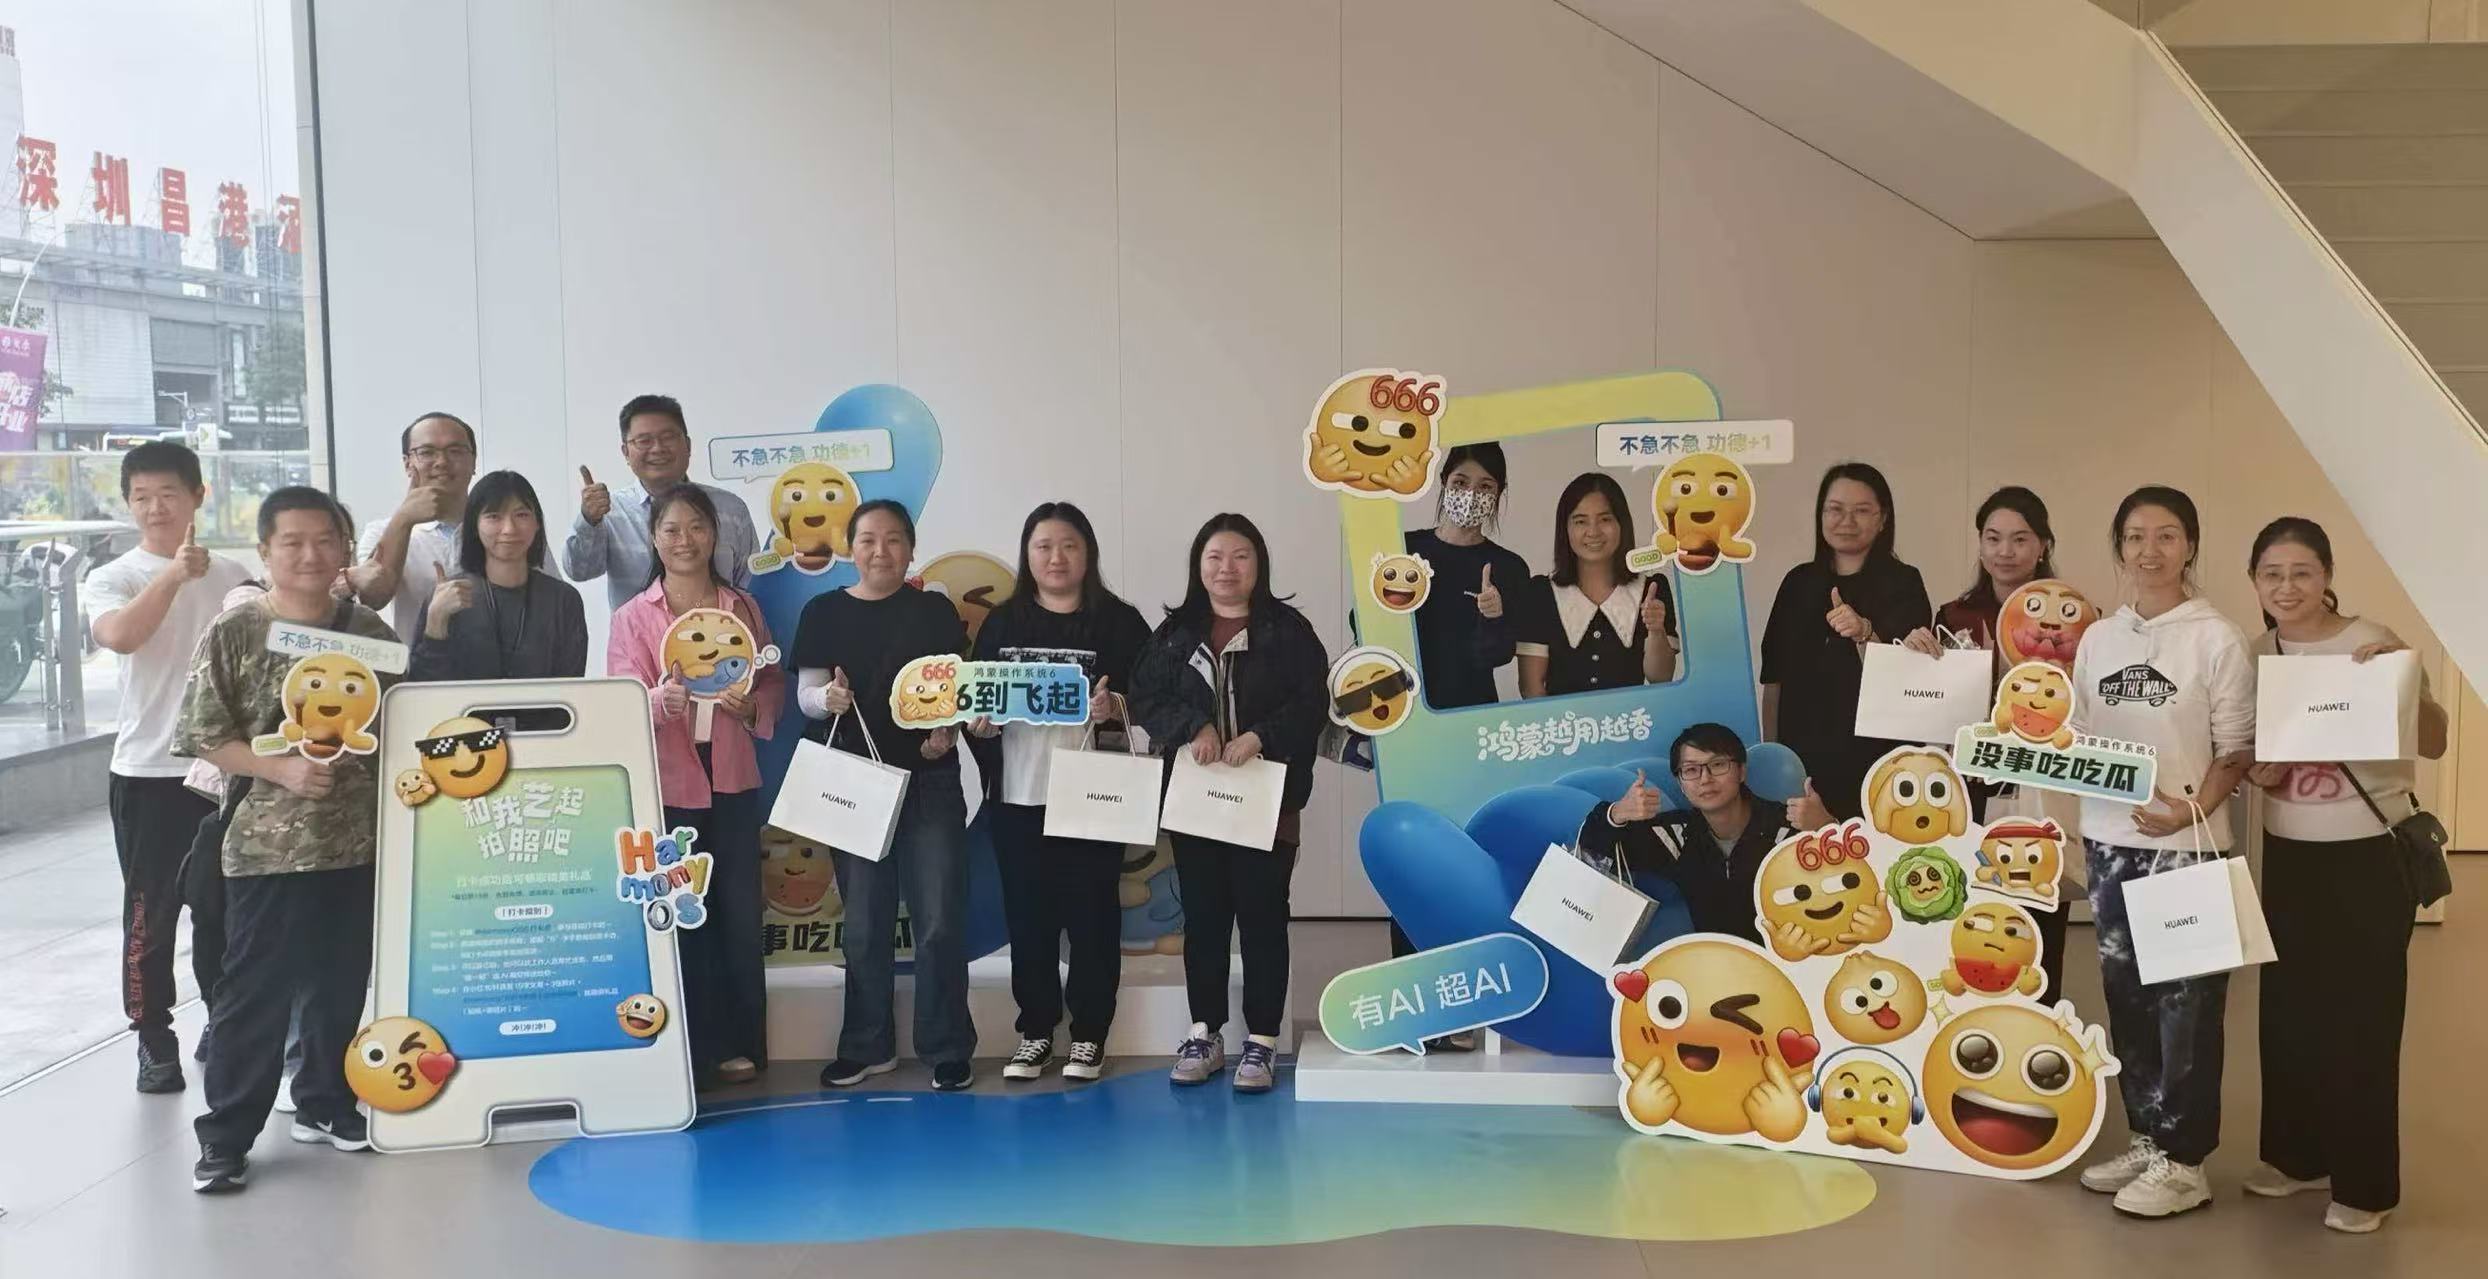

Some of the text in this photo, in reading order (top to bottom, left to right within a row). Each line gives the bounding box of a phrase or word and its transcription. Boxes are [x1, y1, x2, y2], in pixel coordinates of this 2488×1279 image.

[1370, 374, 1441, 416] 666
[731, 441, 871, 468] 不急不急 功德+1
[1619, 432, 1772, 456] 不急不急 功德+1
[921, 661, 957, 681] 666
[973, 666, 1057, 679] 鸿蒙操作系统6
[2121, 667, 2151, 681] VANS
[956, 680, 1081, 716] 6到飞起
[1903, 688, 1945, 700] HUAWEI
[2122, 680, 2141, 697] THE
[2307, 702, 2351, 715] HUAWEI
[1477, 706, 1654, 762] 鸿蒙越用越香
[2075, 734, 2156, 757] 鸿蒙操作系统6
[1970, 740, 2141, 793] 没事吃吃瓜
[459, 781, 585, 829] 和我艺起
[821, 791, 857, 811] HUAWEI
[1086, 792, 1124, 804] HUAWEI
[1207, 789, 1245, 805] HUAWEI
[477, 827, 572, 864] 拍照吧
[619, 830, 694, 875] Har
[1795, 822, 1871, 872] 666
[621, 856, 709, 902] mony
[646, 893, 703, 932] OS
[1561, 897, 1595, 923] HUAWEI
[2164, 915, 2200, 930] HUAWEI
[1348, 961, 1513, 1031] 有AI 超AI
